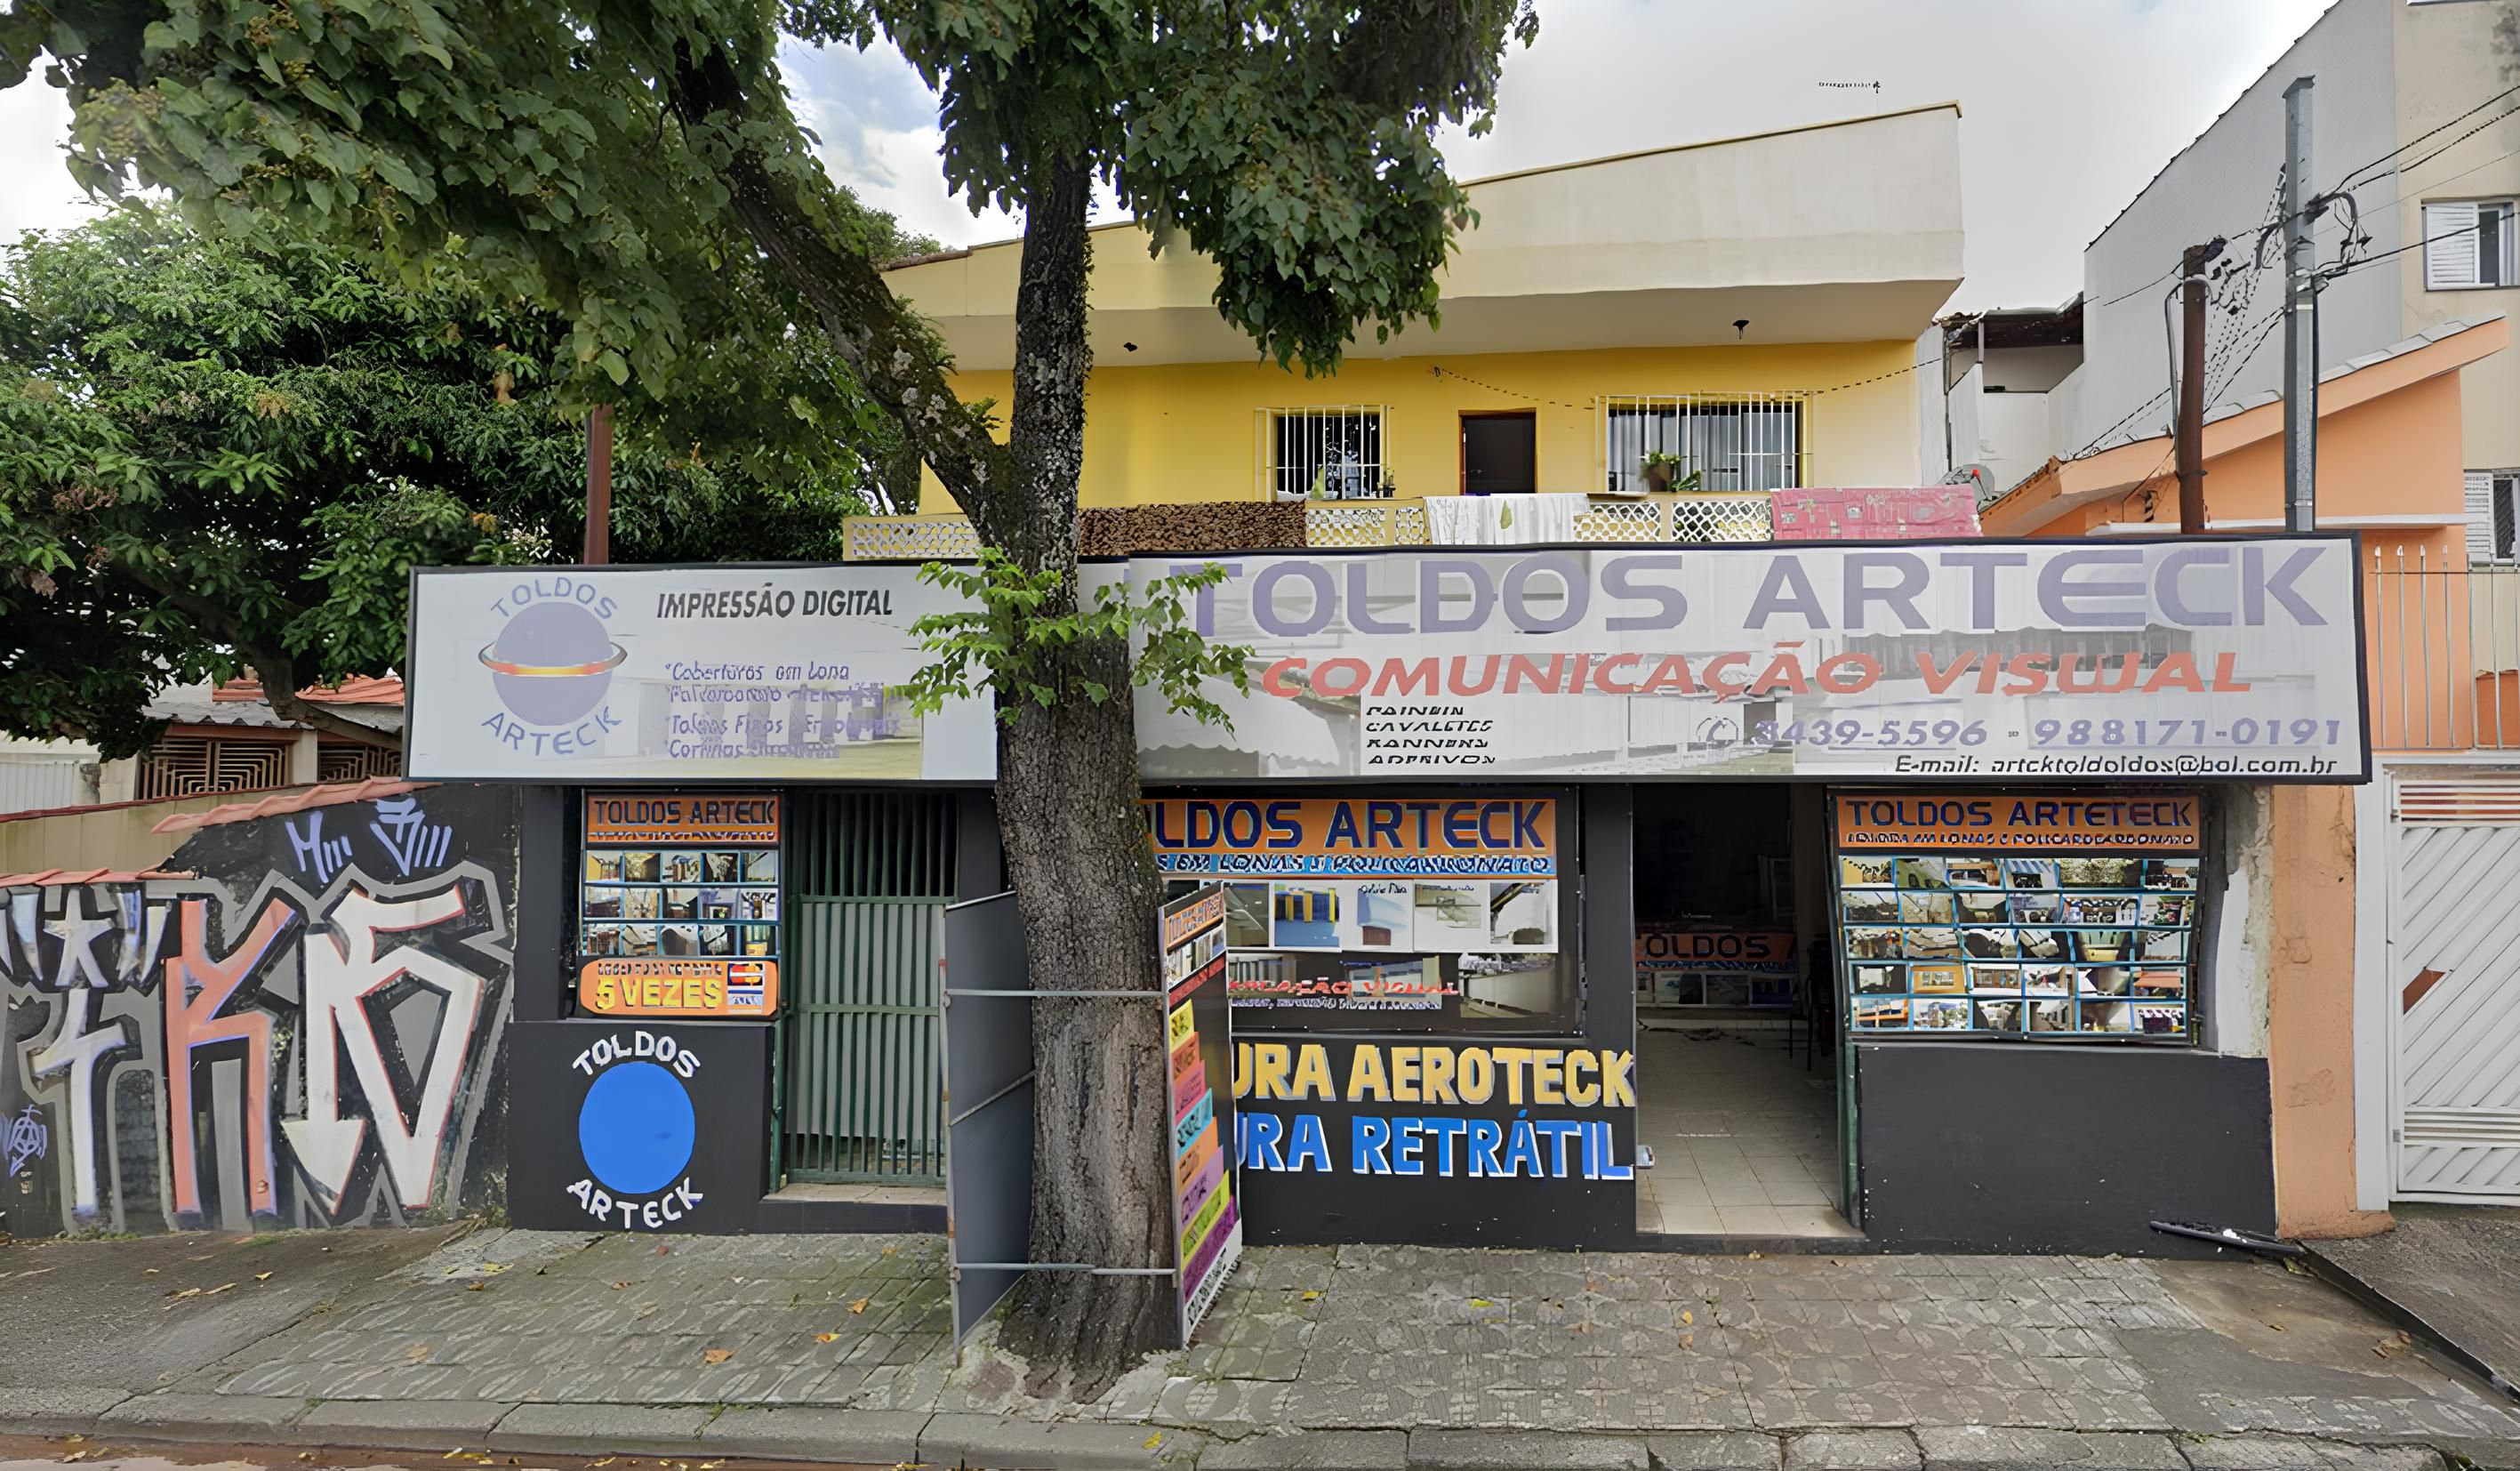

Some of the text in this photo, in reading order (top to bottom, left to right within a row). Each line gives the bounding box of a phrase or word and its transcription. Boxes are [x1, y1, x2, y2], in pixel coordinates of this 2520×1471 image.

[491, 576, 618, 620] TOLDOS
[656, 583, 893, 618] IMPRESSÃO DIGITAL
[1169, 546, 2329, 637] TOLDOS ARTECK
[1262, 641, 2252, 703] COMUNICAÇÃO VISUAL
[481, 706, 622, 756] ARTECK
[1895, 754, 1979, 773] E-mail:
[594, 800, 775, 825] TOLDOS ARTECK
[1152, 801, 1547, 848] LDOS ARTECK
[1846, 800, 1993, 826] TOLDOS
[1636, 935, 1770, 958] OLDOS
[595, 978, 723, 1010] 5 VEZES
[572, 1030, 702, 1078] TOLDOS
[1347, 1044, 1635, 1107] AEROTECK
[1352, 1109, 1634, 1180] RETRÁTIL
[566, 1177, 703, 1230] ARTECK
